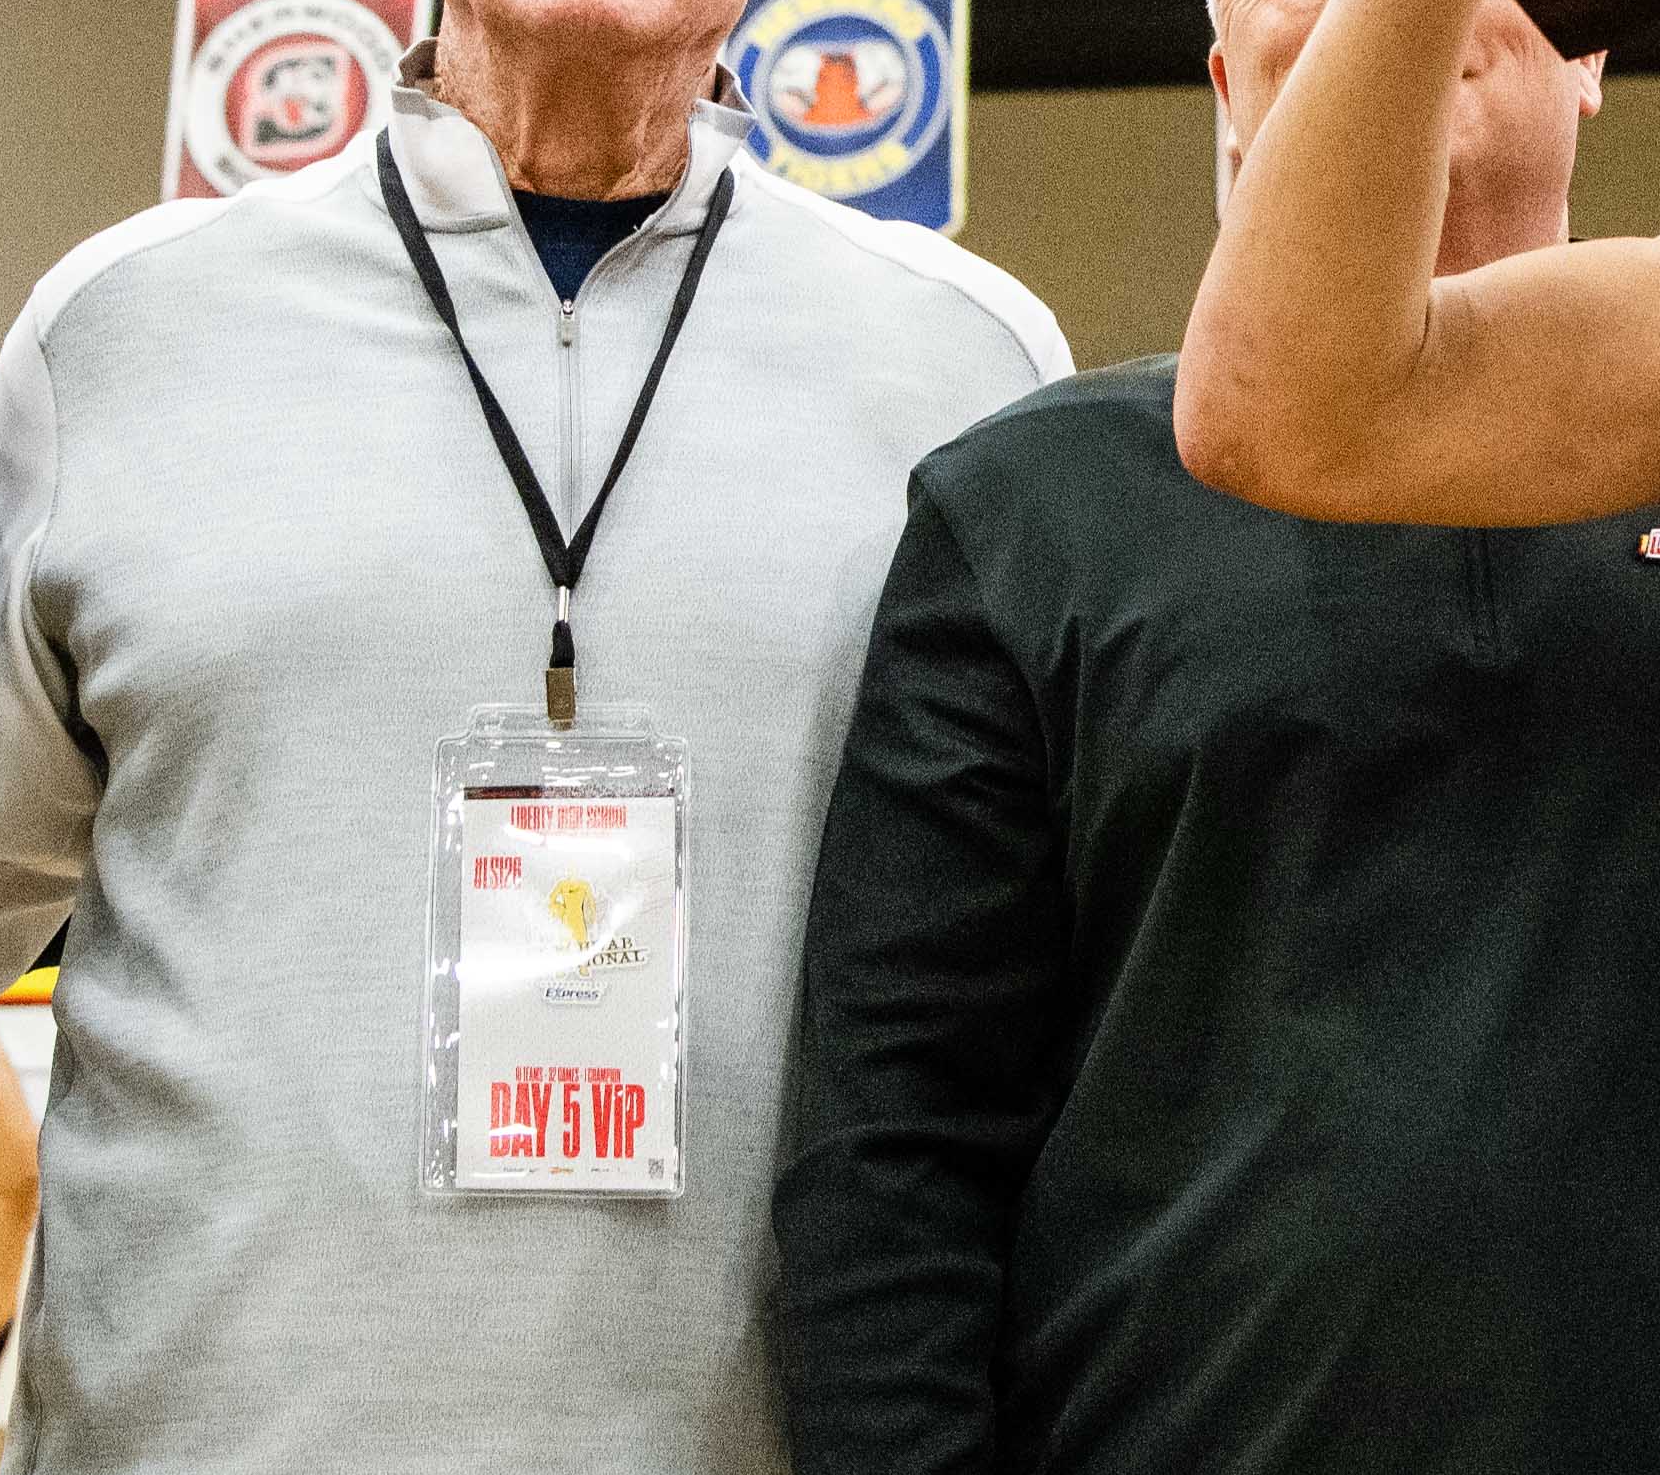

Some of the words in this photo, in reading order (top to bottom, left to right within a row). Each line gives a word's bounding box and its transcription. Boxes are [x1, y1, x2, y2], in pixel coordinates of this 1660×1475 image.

[511, 804, 553, 829] LIBERTY
[586, 804, 629, 829] SCHOOL
[490, 1082, 552, 1158] DAY
[562, 1082, 581, 1158] 5
